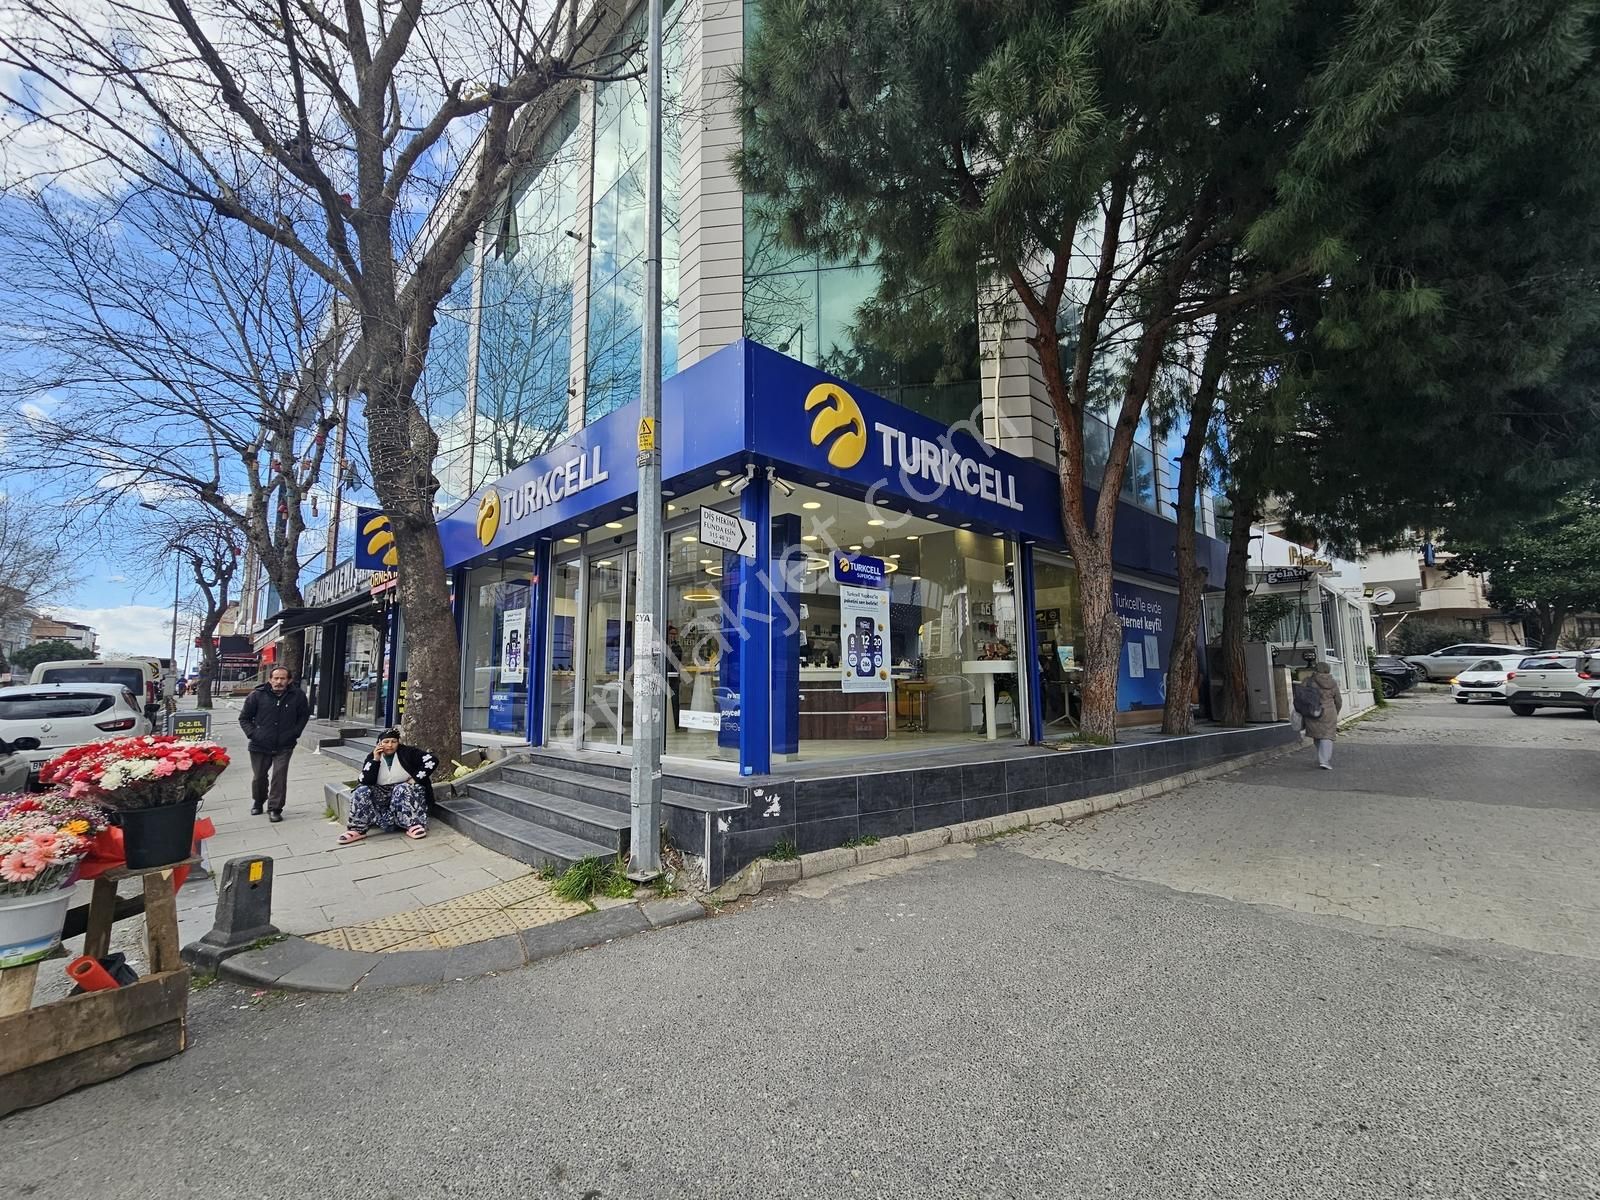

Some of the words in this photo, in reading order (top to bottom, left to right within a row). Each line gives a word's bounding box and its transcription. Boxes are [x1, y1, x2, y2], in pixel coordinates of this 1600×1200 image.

[875, 421, 1024, 512] TURKCELL
[503, 445, 609, 525] TURKCELL
[703, 510, 715, 522] DİŞ
[703, 521, 724, 533] FUNDA
[849, 562, 881, 575] TURKCELL
[1114, 592, 1146, 612] Turkcell'le
[1147, 601, 1162, 615] evde
[1144, 616, 1163, 634] keyfi!
[850, 636, 855, 645] 8
[861, 635, 870, 645] 12
[873, 638, 882, 646] 20
[721, 709, 741, 718] paycell
[175, 727, 206, 735] TELEFON
